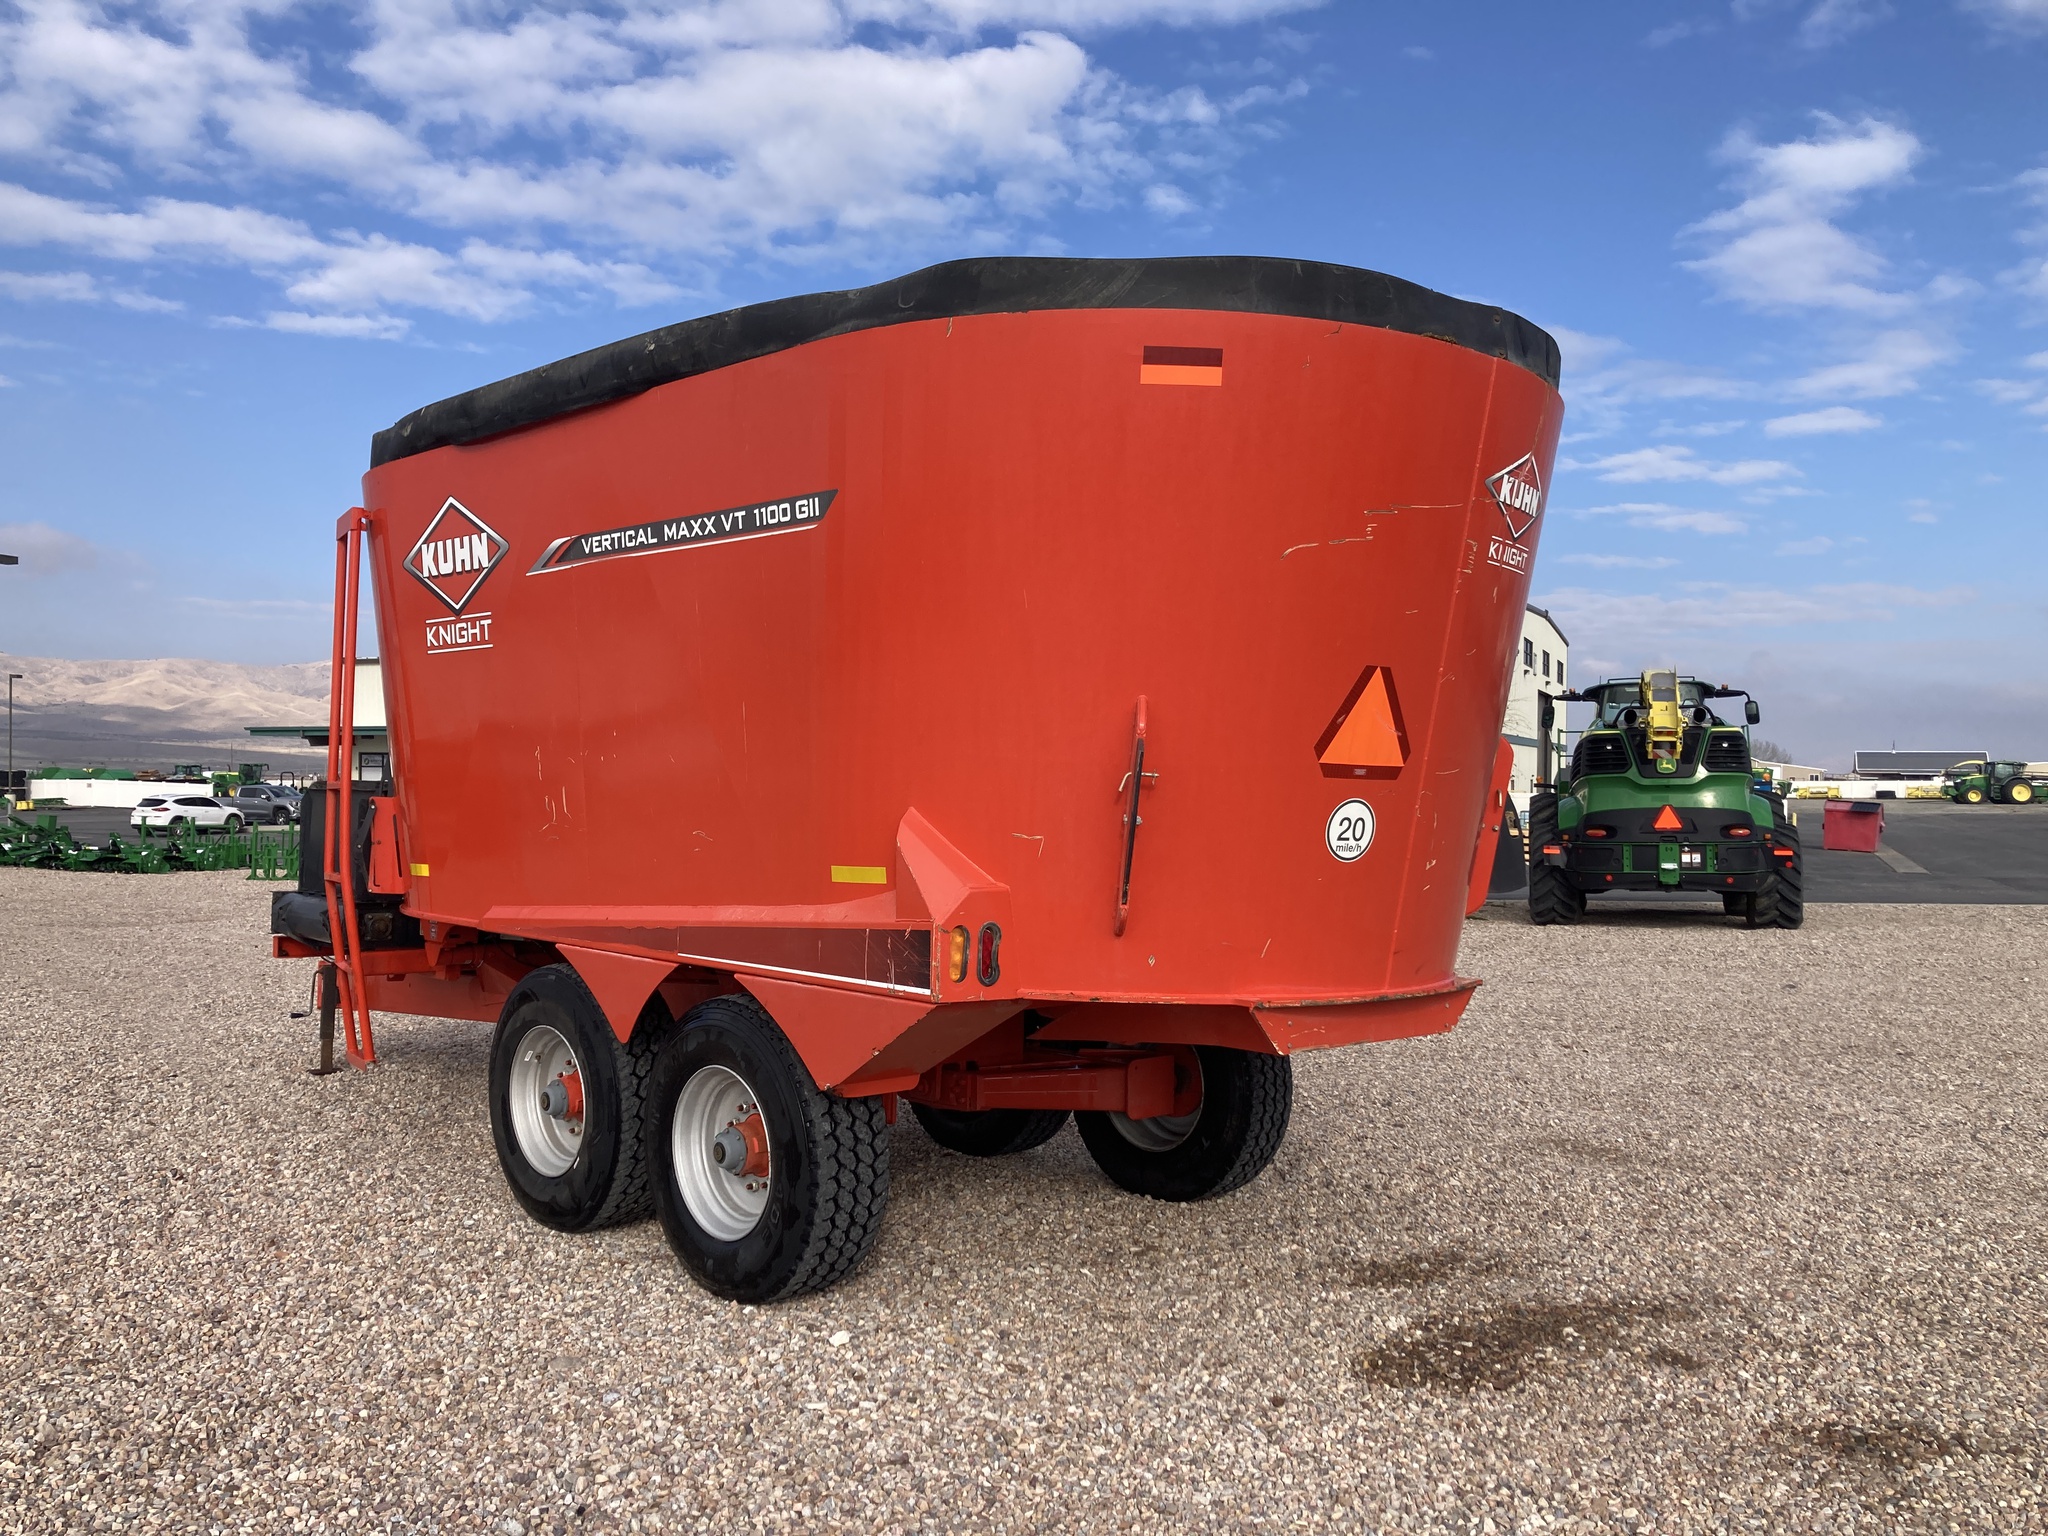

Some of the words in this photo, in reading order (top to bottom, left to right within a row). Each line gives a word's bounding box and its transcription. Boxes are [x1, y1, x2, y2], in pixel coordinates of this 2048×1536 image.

[1500, 474, 1540, 518] KUHN
[581, 526, 658, 554] VERTICAL
[664, 515, 717, 541] MAXX
[720, 510, 746, 532] VT
[753, 502, 791, 527] 1100
[421, 532, 489, 578] KUHN
[426, 619, 492, 647] KNIGHT
[1336, 816, 1366, 842] 20
[1335, 843, 1362, 852] mile/h
